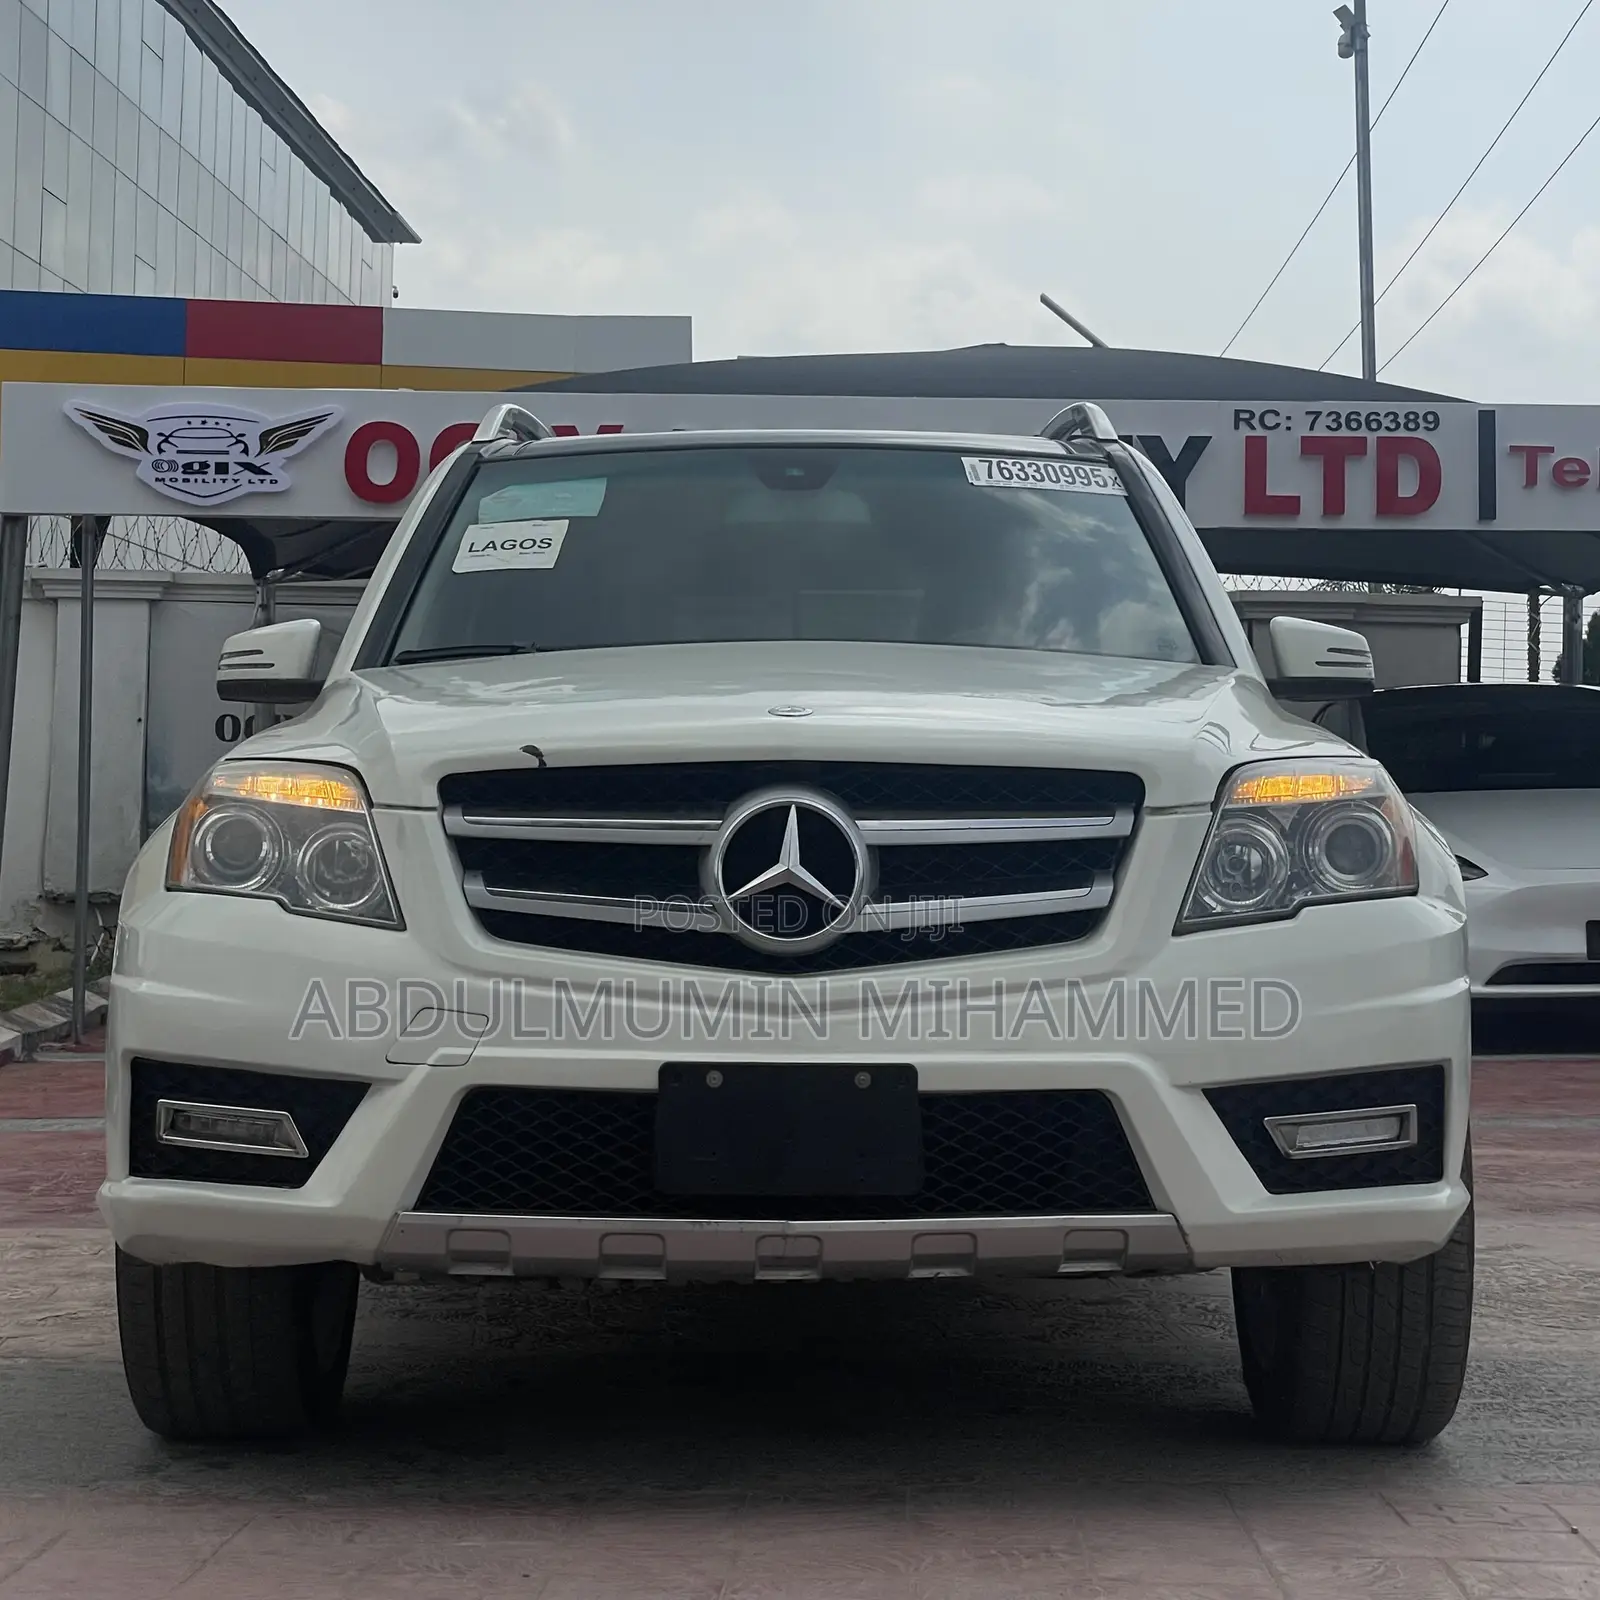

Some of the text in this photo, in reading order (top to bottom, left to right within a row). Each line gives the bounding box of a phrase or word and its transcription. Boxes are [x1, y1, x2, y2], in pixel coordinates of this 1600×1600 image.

[1233, 408, 1441, 432] RC: 7366389
[978, 459, 1109, 488] 76330995
[1243, 435, 1443, 517] LTD
[1508, 444, 1600, 489] Te
[467, 537, 553, 554] LAGOS
